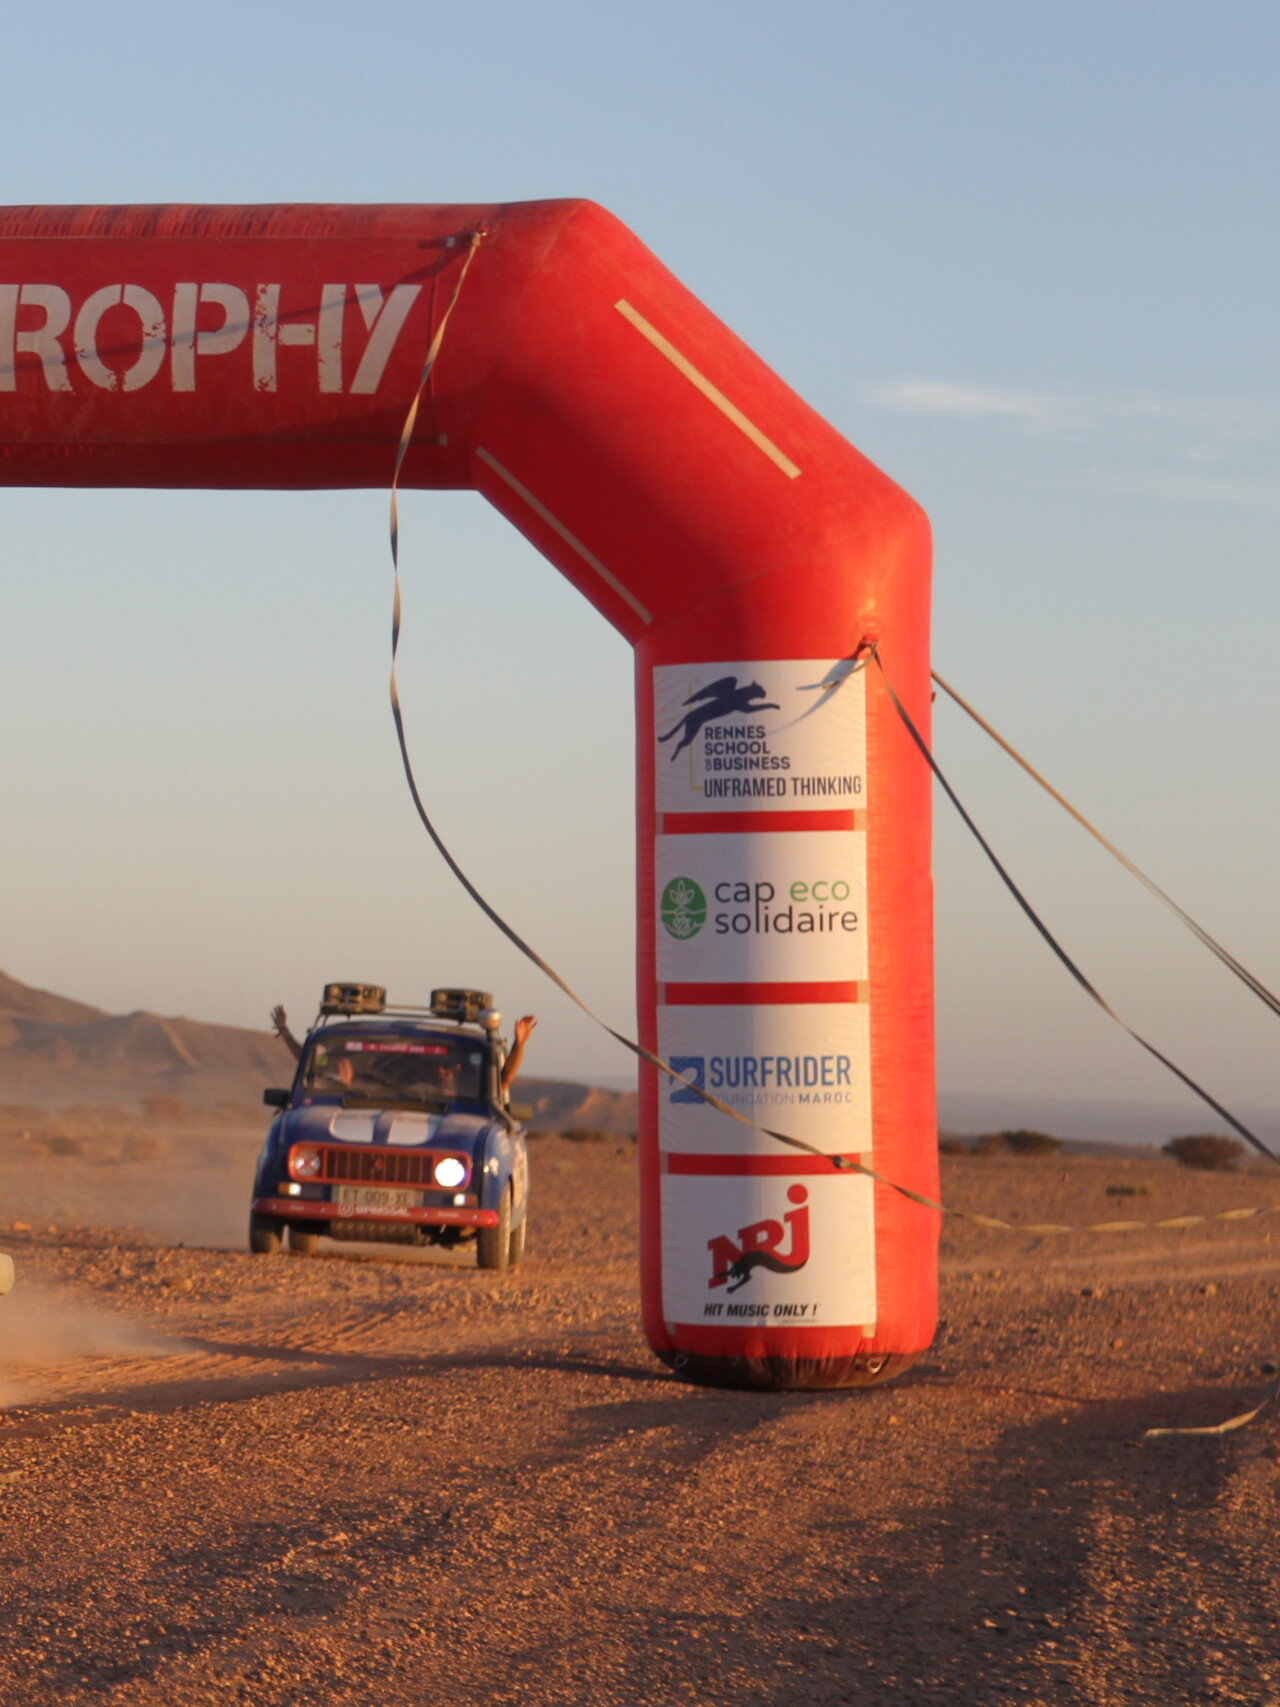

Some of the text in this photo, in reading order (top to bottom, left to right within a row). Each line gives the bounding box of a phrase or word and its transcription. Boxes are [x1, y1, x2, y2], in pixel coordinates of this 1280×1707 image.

[704, 726, 766, 739] RENNES
[704, 741, 771, 755] SCHOOL
[713, 756, 790, 770] BUSINESS
[704, 775, 862, 798] UNFRAMED THINKING
[714, 880, 850, 907] cap eco
[715, 905, 858, 934] solidaire
[709, 1056, 852, 1087] SURFRIDER
[710, 1091, 794, 1105] OUNDATION
[704, 1303, 724, 1317] HIT
[726, 1303, 770, 1317] MUSIC
[773, 1303, 808, 1317] ONLY
